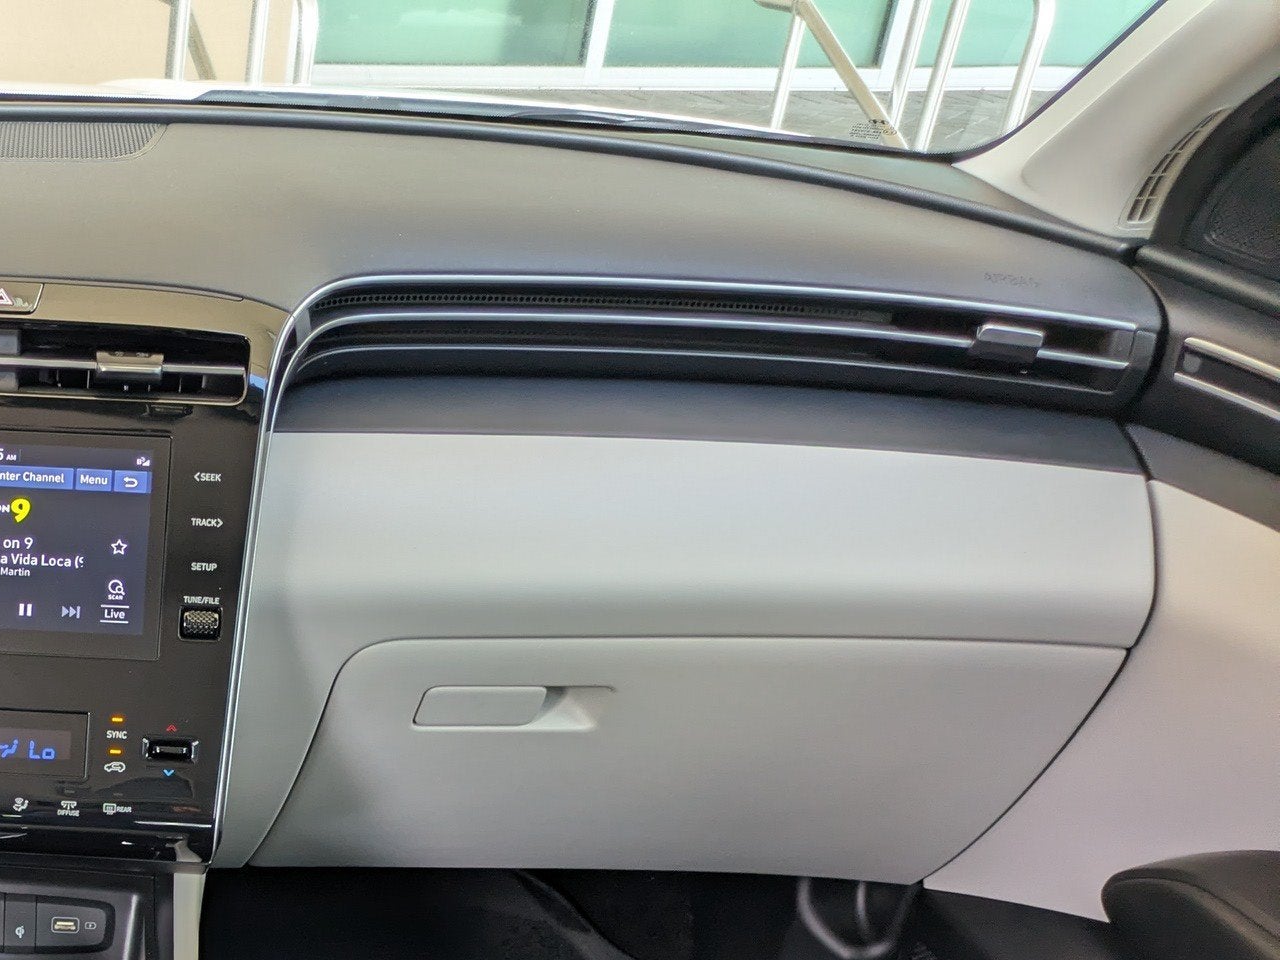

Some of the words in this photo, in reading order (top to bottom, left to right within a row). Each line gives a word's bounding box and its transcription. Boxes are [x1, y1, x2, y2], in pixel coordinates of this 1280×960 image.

[23, 471, 65, 484] Channel
[80, 474, 108, 486] Menu
[200, 472, 222, 482] SEEK
[11, 497, 32, 523] 9
[191, 517, 217, 528] TRACK
[3, 538, 20, 549] on
[24, 537, 34, 550] 9
[11, 553, 38, 565] Vida
[41, 555, 71, 567] Loca
[0, 567, 31, 577] Martin
[191, 562, 218, 571] SETUP
[183, 595, 220, 605] TUNE/FILE
[104, 608, 126, 619] Live
[106, 730, 128, 740] SYNC
[29, 739, 56, 760] Lo
[57, 808, 80, 817] DIFFUSE
[116, 805, 132, 813] REAR
